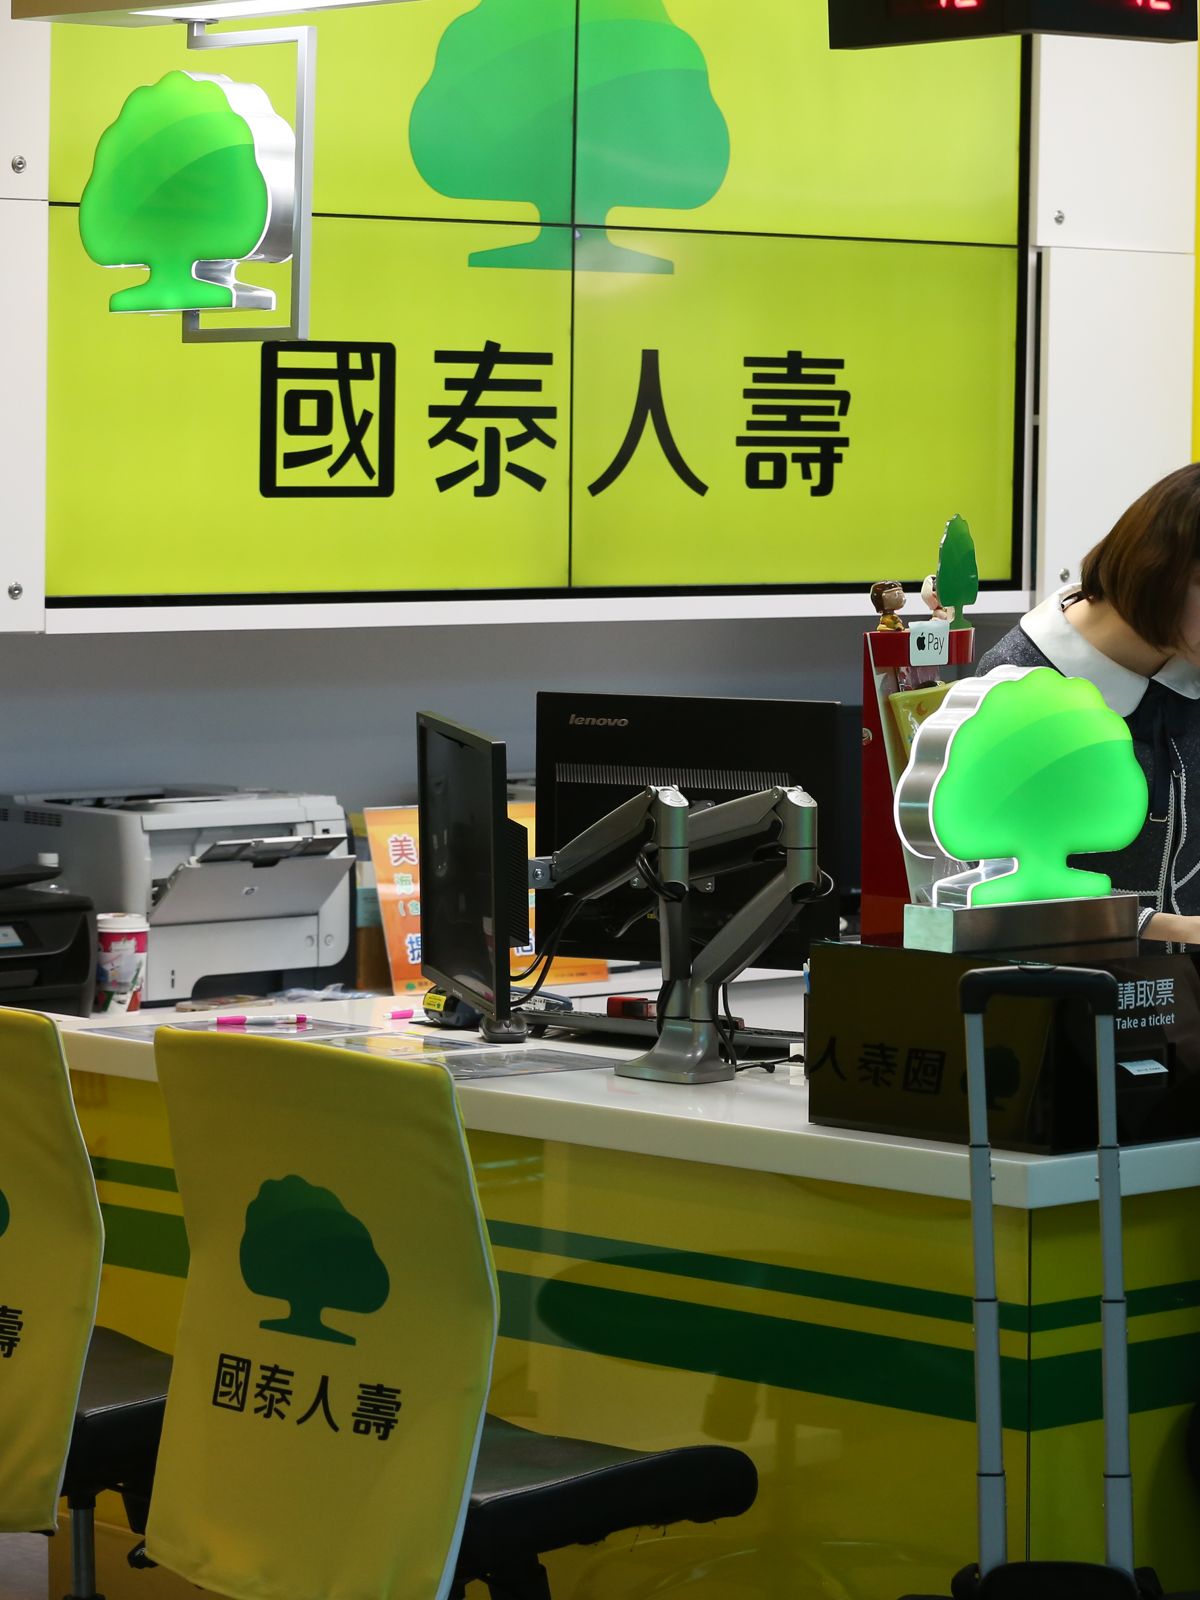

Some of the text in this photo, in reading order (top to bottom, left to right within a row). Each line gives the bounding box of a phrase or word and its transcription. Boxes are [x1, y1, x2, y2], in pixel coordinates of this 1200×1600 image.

[260, 340, 851, 497] 國泰人壽
[927, 633, 945, 655] Pay
[569, 714, 629, 727] lenovo
[1117, 979, 1175, 1010] 請取票
[1116, 1013, 1175, 1030] Take a ticket
[212, 1353, 402, 1440] 國泰人壽
